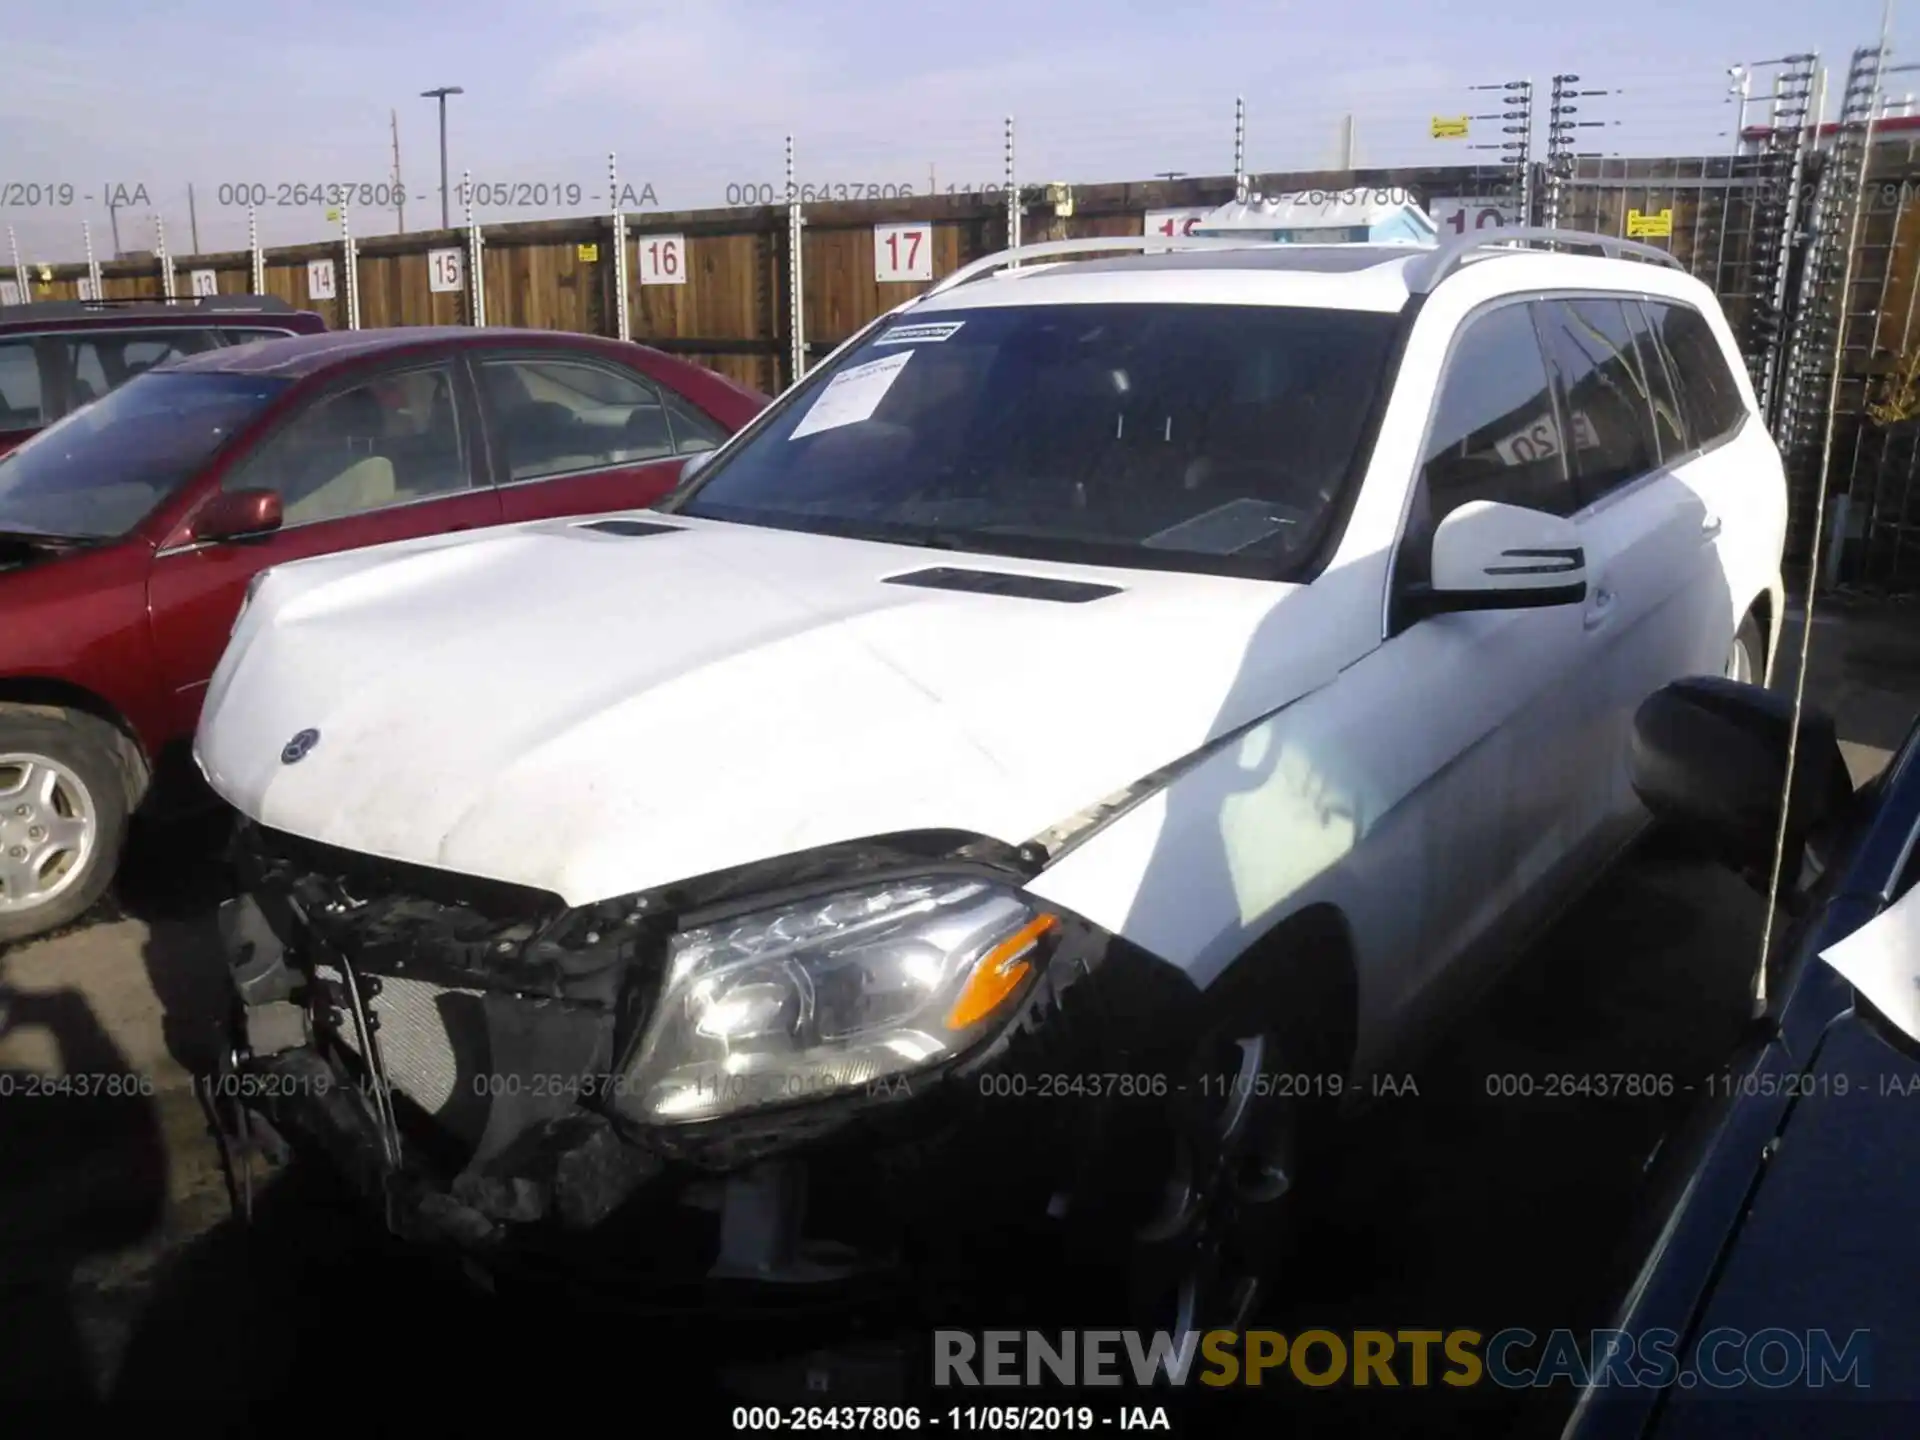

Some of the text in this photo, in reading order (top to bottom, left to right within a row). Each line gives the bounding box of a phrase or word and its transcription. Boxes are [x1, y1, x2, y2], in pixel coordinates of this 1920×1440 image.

[648, 241, 678, 276] 16
[885, 232, 922, 271] 17
[311, 268, 331, 291] 14
[433, 256, 457, 283] 15
